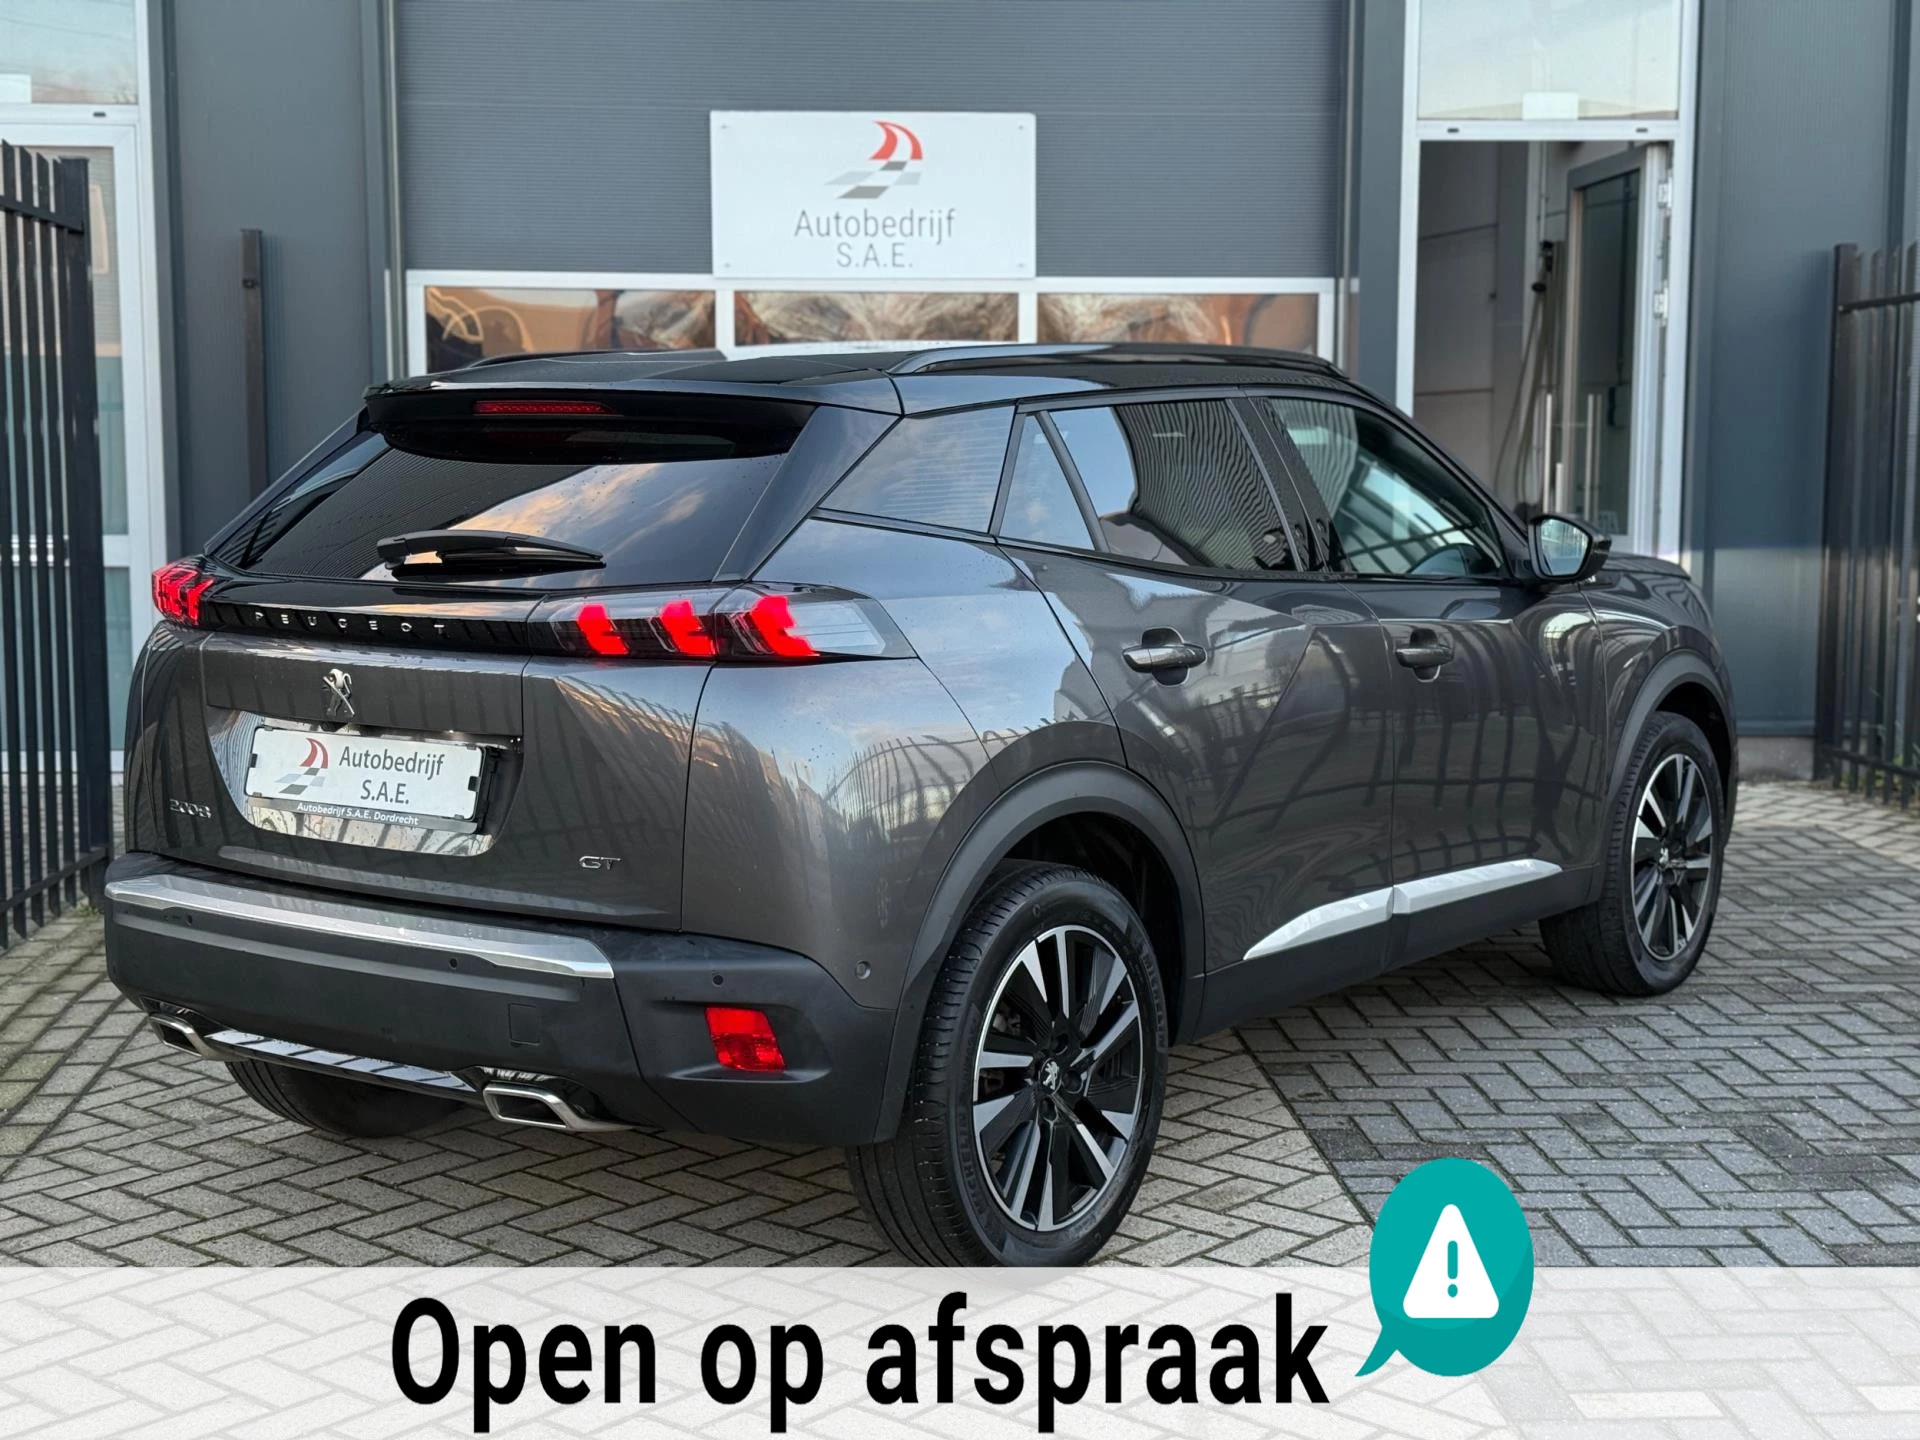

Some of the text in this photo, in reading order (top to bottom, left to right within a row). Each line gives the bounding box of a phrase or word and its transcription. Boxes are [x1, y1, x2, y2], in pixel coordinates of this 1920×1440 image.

[794, 208, 956, 245] Autobedrijf
[836, 242, 913, 268] S.A.E.
[254, 611, 445, 635] PEUGEOT
[339, 746, 444, 780] Autobedrijf
[360, 779, 409, 805] S.A.E.
[297, 802, 419, 826] Autobedrijf S.A.E. Dordrecht
[579, 855, 621, 870] GT
